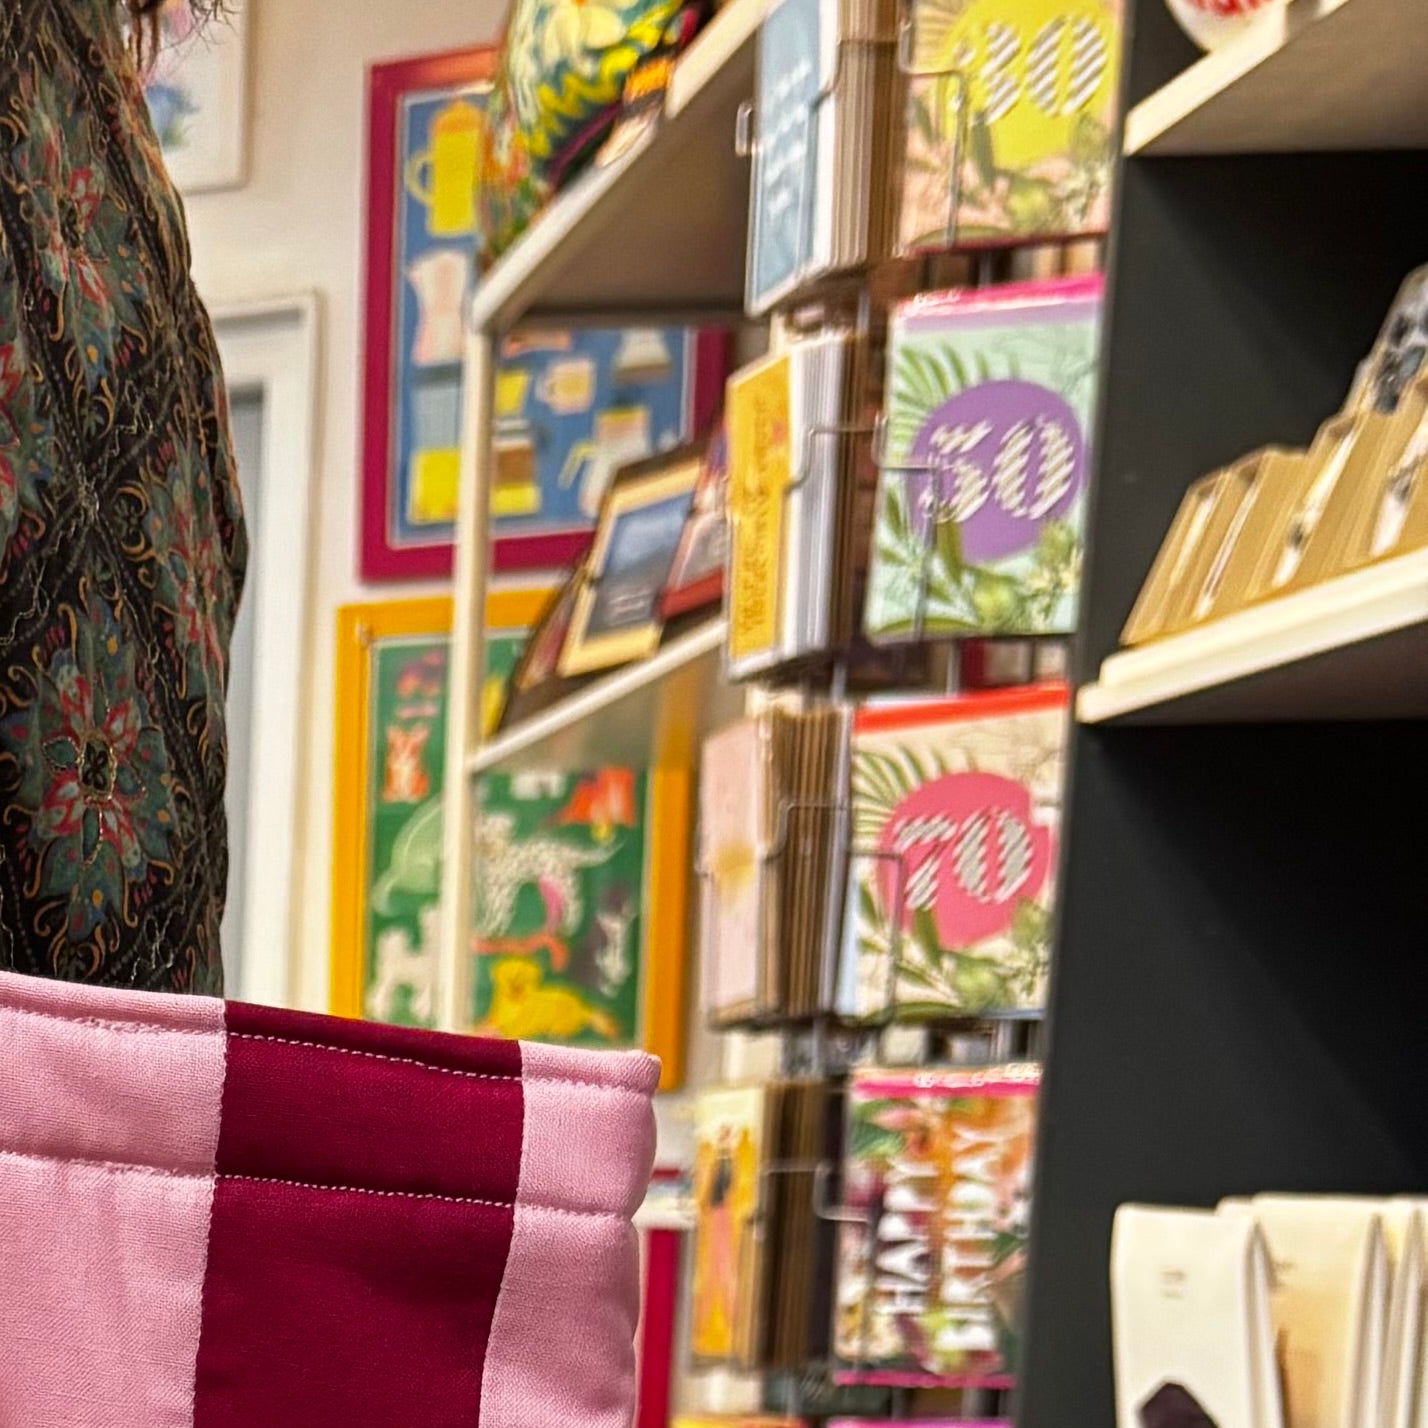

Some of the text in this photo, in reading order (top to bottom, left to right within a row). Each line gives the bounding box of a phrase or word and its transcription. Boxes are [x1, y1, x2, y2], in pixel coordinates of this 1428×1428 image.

[918, 413, 1075, 523] 50
[894, 807, 1034, 910] 70
[874, 1156, 939, 1315] HAPPY
[935, 1122, 1001, 1351] BIRTHDAY
